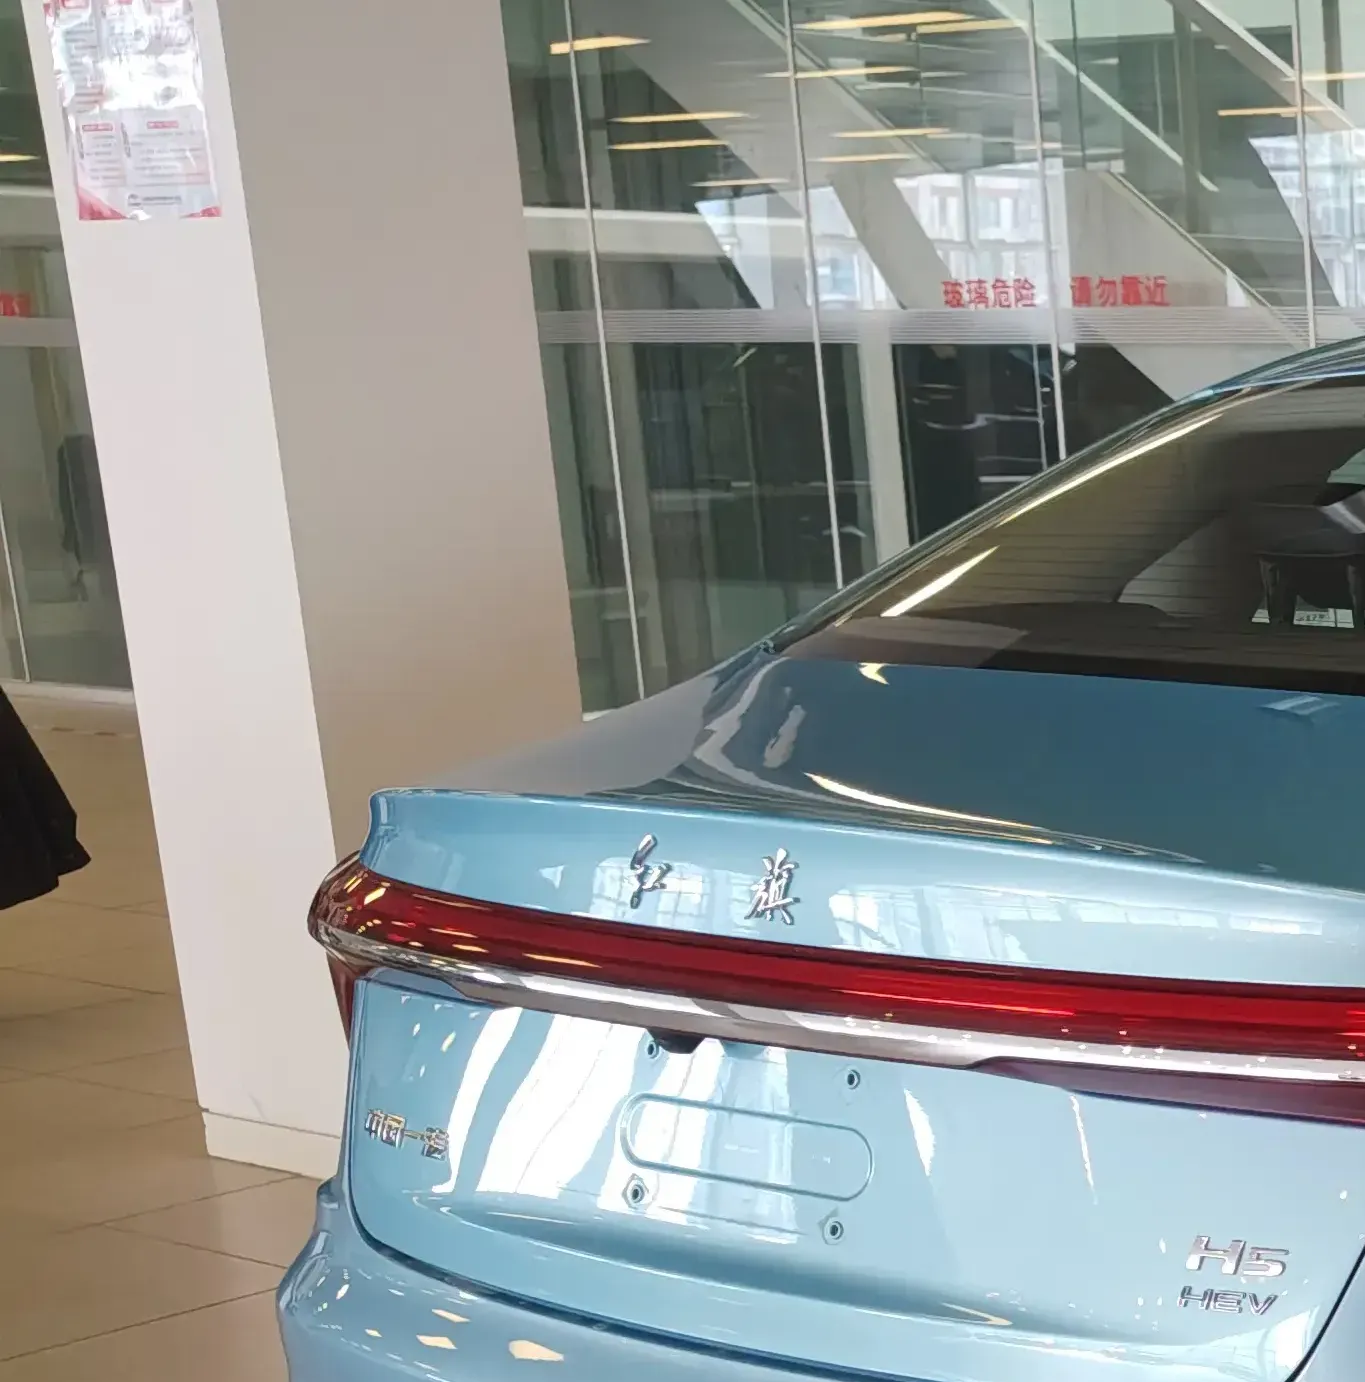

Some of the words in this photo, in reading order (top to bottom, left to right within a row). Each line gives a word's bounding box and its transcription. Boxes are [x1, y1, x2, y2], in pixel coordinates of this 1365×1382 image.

[941, 277, 1037, 308] 玻璃危险
[1070, 275, 1171, 308] 请勿靠近
[1185, 1234, 1290, 1278] H5
[1177, 1285, 1279, 1316] HEV
